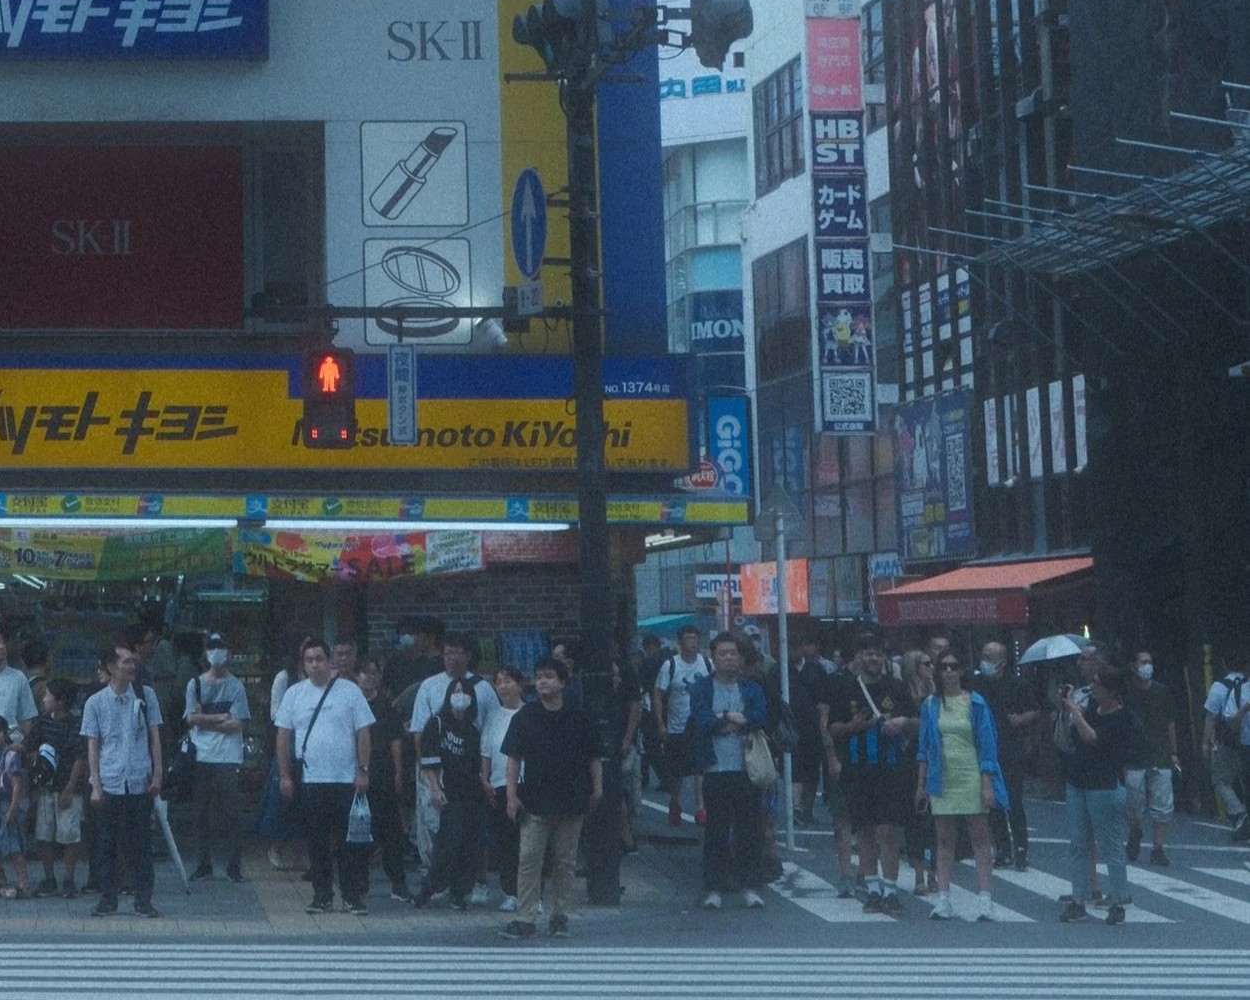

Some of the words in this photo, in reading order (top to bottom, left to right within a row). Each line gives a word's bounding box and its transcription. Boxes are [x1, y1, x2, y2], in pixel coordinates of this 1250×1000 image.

[815, 119, 859, 139] HB
[816, 143, 859, 164] ST
[818, 184, 861, 206] カード
[819, 209, 864, 231] ゲーム
[821, 248, 863, 270] 販売
[822, 273, 866, 295] 買取
[502, 421, 632, 449] KiYohi
[246, 551, 344, 575] ウルトラサマー
